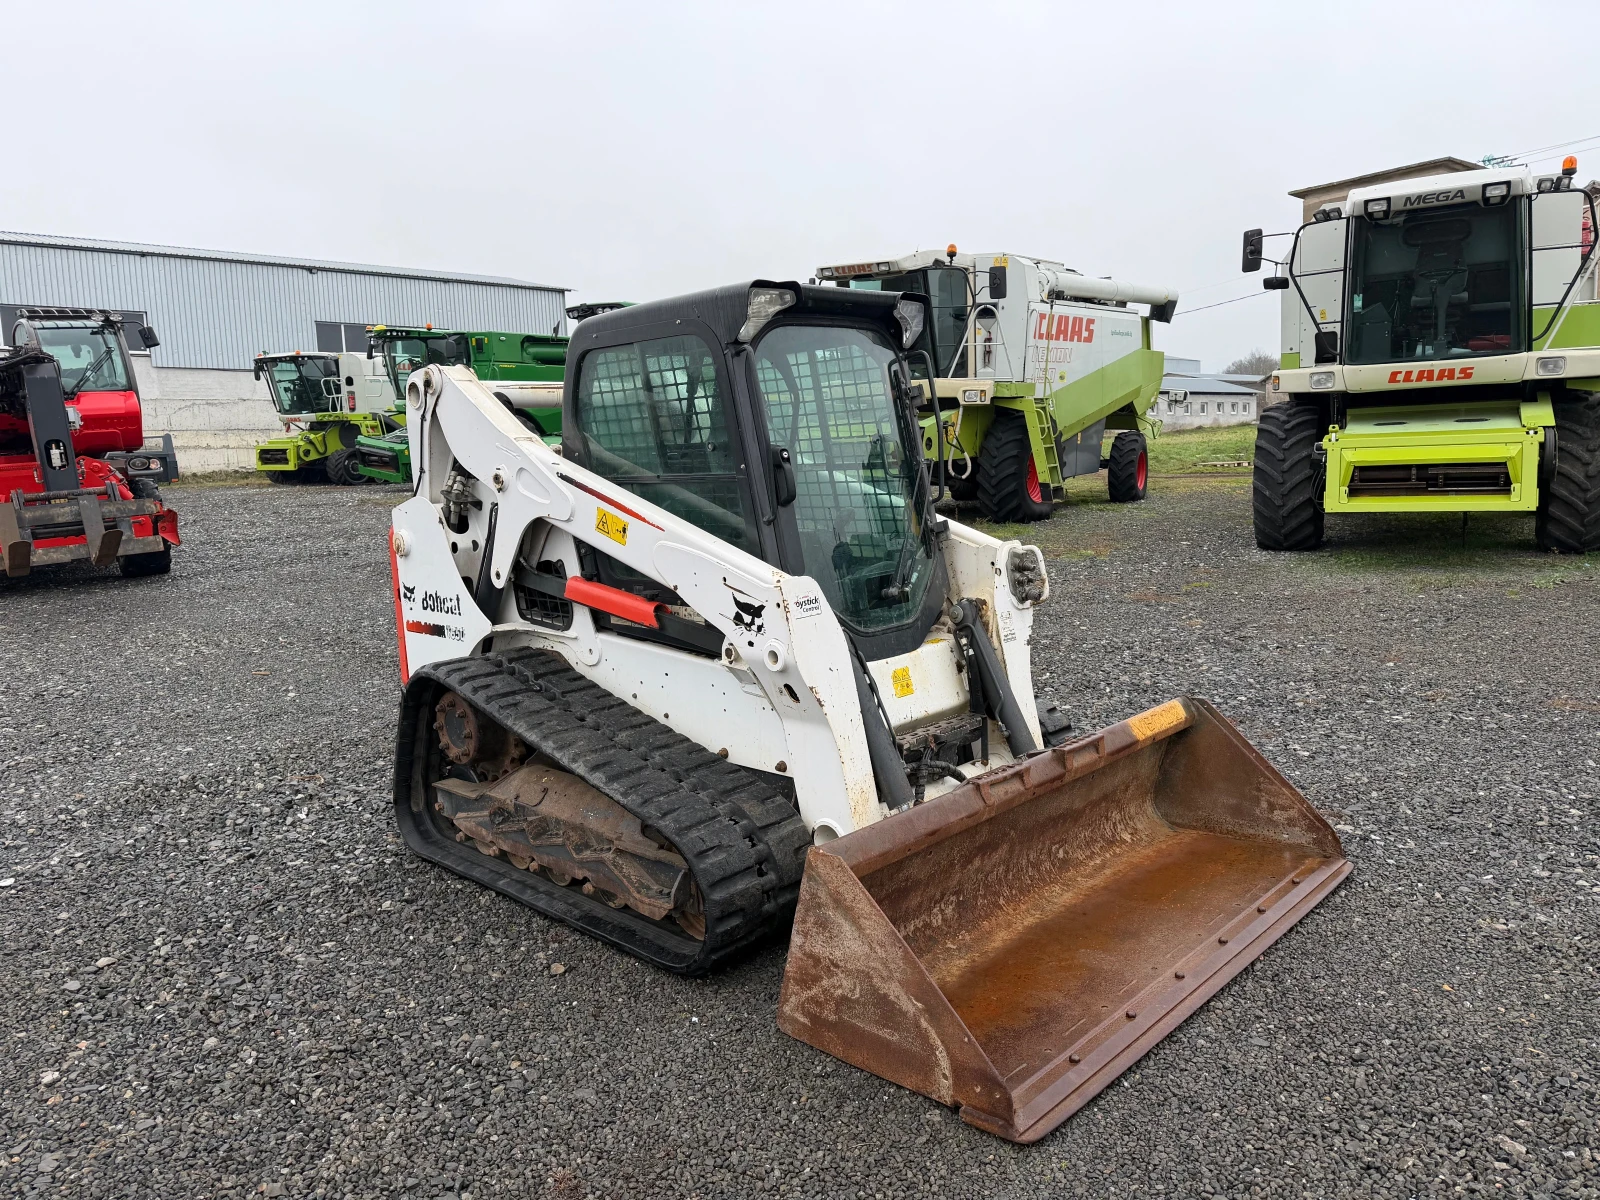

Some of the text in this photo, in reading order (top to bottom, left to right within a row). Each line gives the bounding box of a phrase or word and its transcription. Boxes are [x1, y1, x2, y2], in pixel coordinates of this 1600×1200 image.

[1403, 190, 1466, 207] MEGA
[834, 263, 874, 275] CLAAS
[1034, 313, 1096, 343] CLAAS
[1387, 366, 1475, 383] CLAAS
